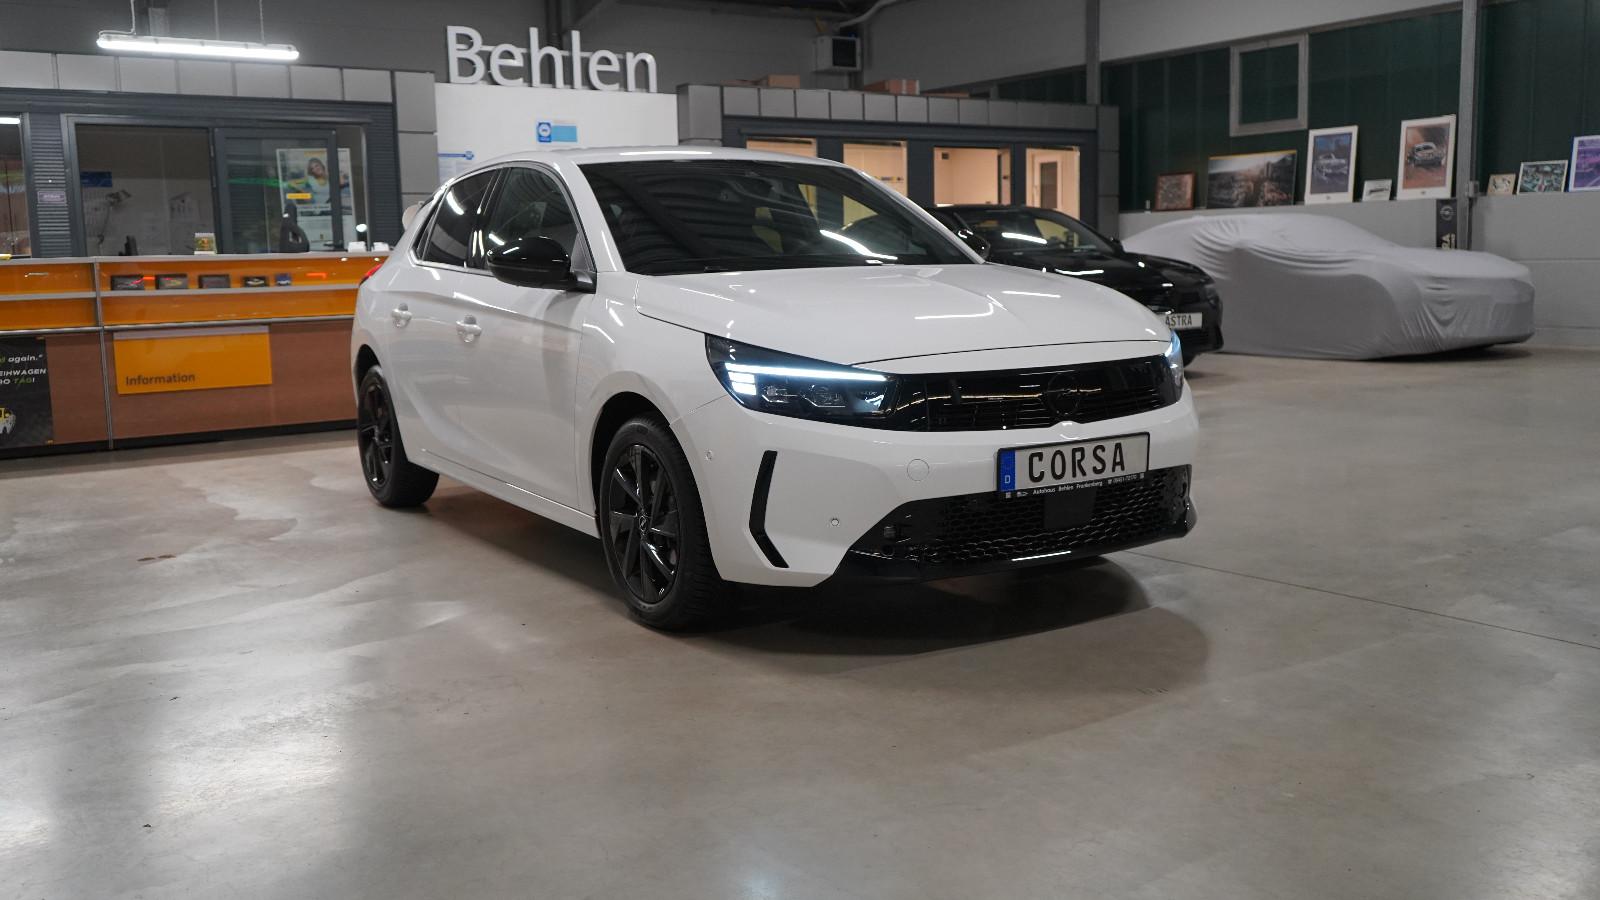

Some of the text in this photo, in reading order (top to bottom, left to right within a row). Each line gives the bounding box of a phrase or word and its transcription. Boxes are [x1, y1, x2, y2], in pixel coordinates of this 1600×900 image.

[446, 25, 658, 93] Behlen
[1165, 314, 1192, 327] ASTRA
[126, 373, 196, 386] Information
[1028, 442, 1125, 483] CORSA
[1004, 475, 1011, 484] D
